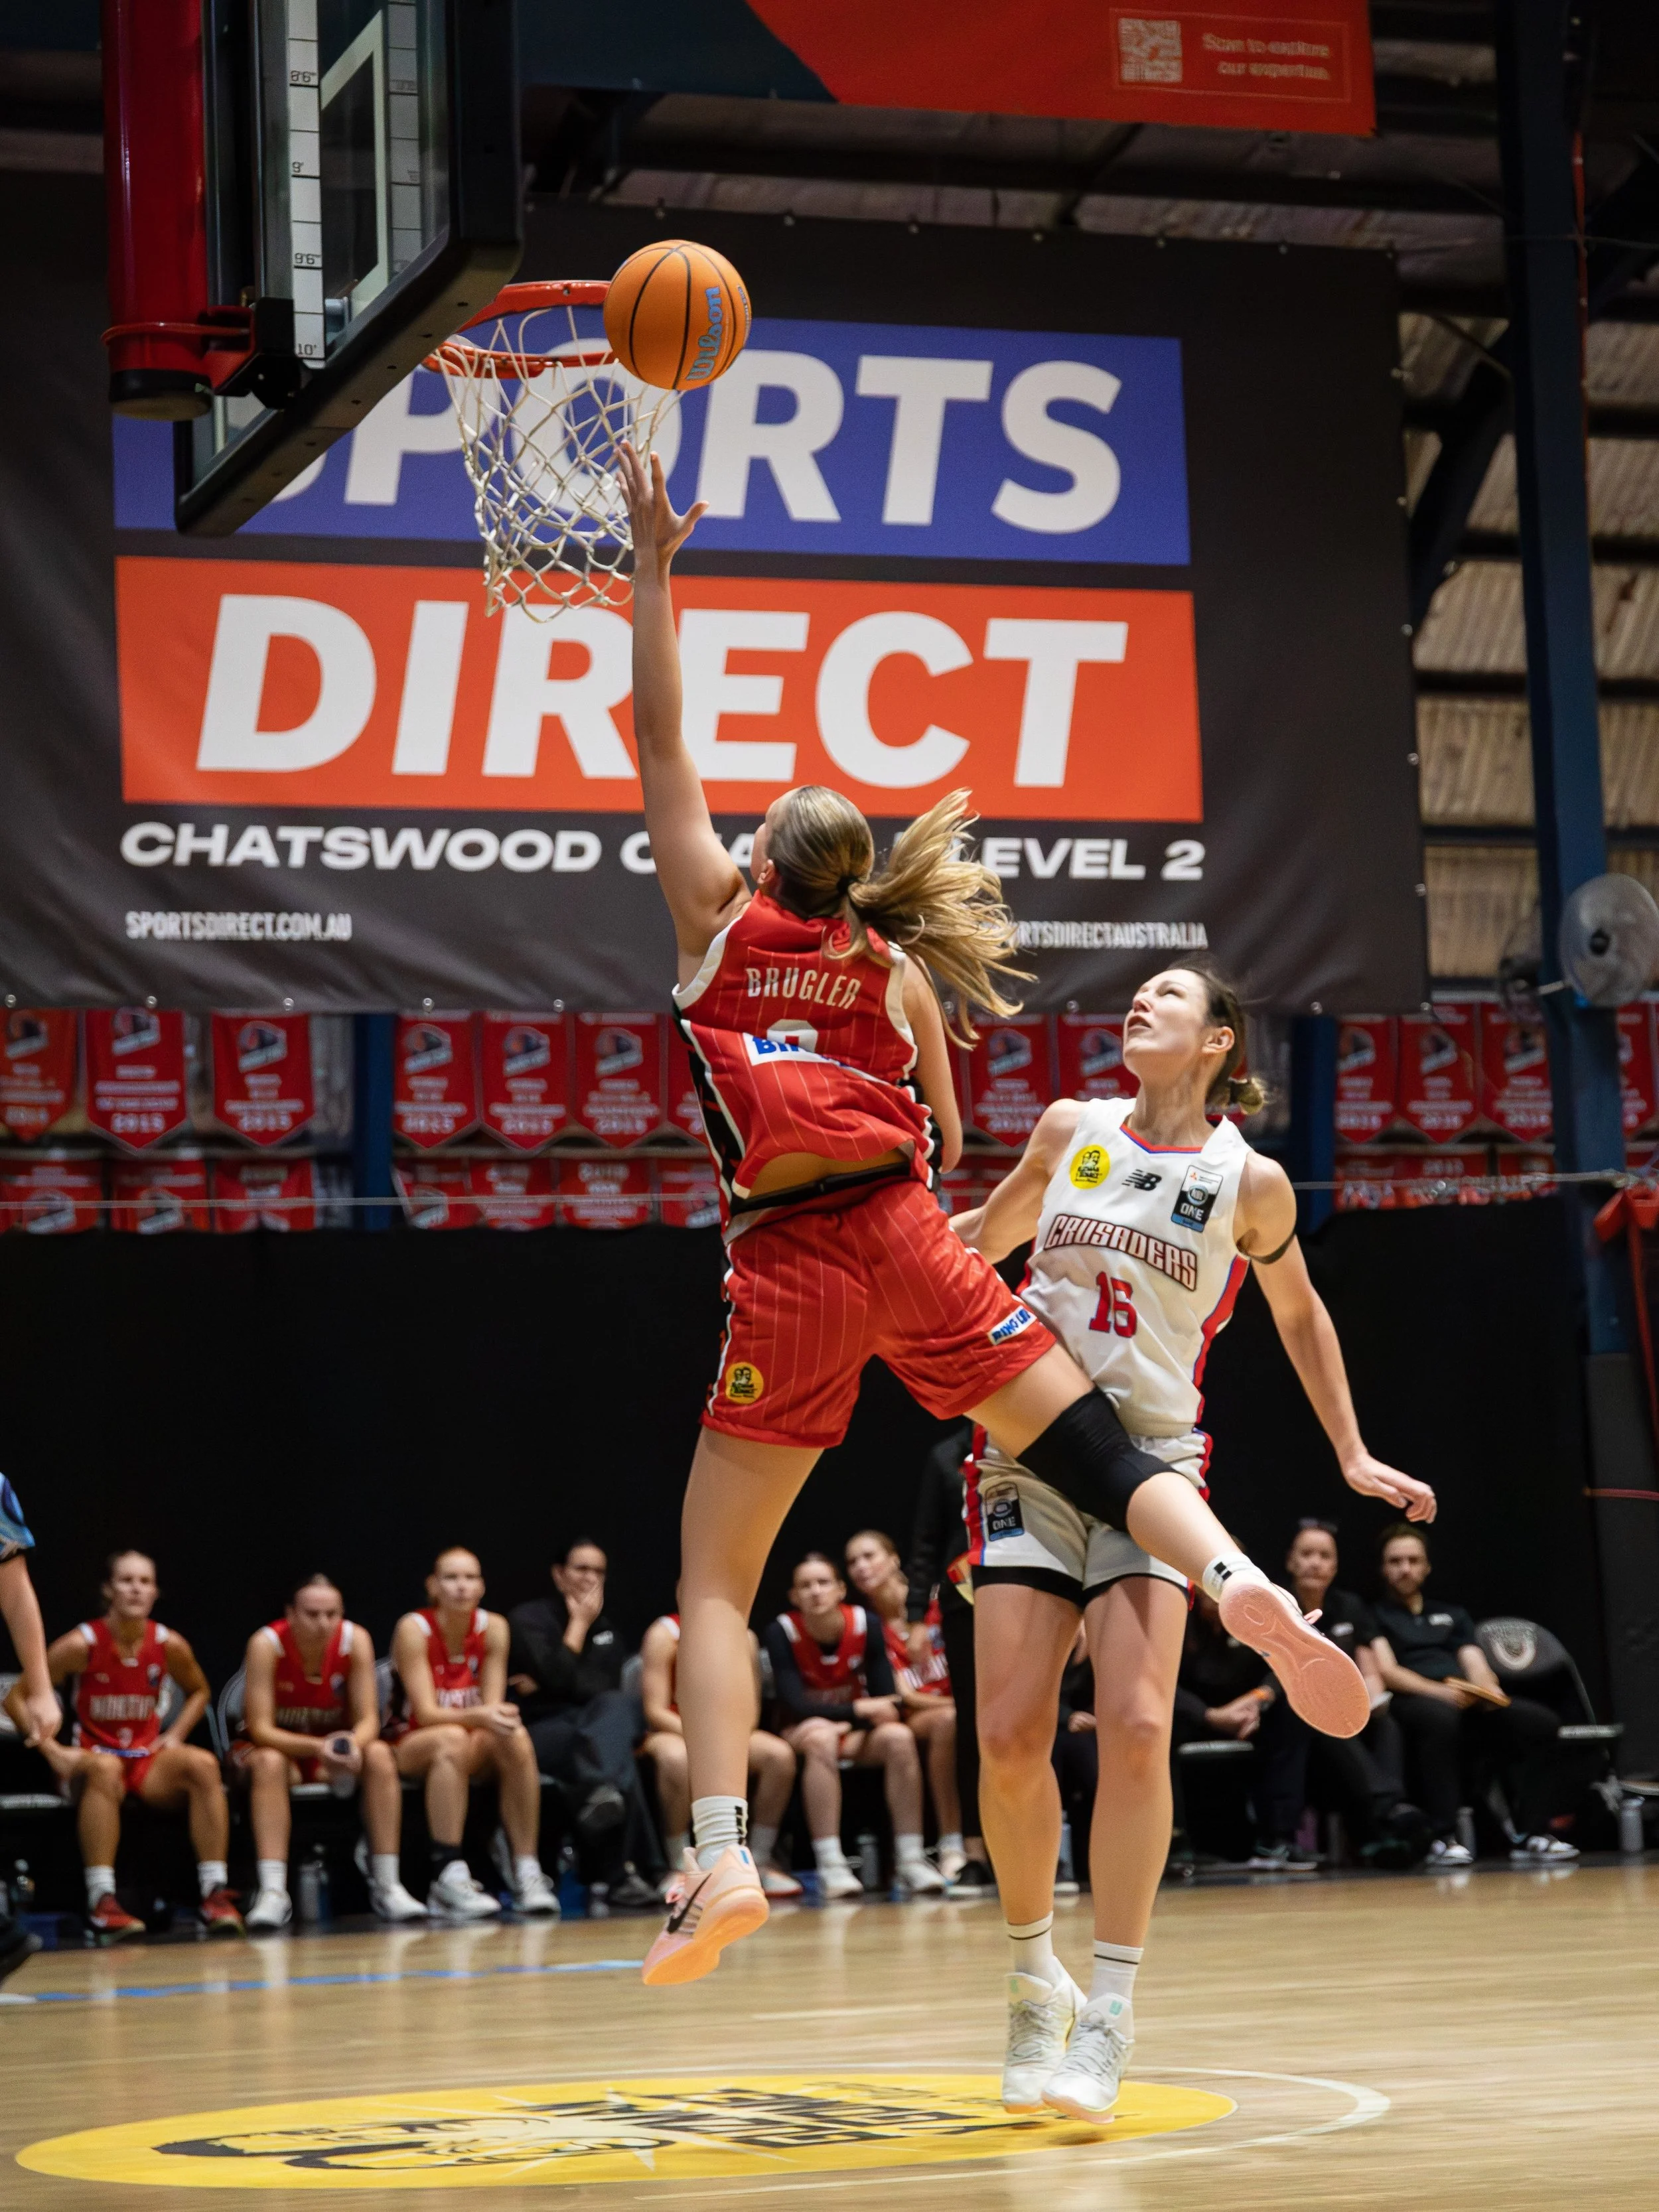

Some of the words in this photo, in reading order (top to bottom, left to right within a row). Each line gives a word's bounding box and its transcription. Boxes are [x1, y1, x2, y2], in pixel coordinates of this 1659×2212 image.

[298, 344, 317, 356] 10'
[685, 286, 723, 381] Wilson
[269, 335, 1121, 535] PORTS
[196, 592, 1129, 790] DIRECT
[120, 822, 603, 873] CHATSWOOD
[1161, 839, 1206, 881] 2
[745, 966, 862, 1010] BRUGLER
[1180, 1203, 1204, 1221] ONE
[1045, 1214, 1197, 1292] CRUSADERS
[992, 1516, 1016, 1531] ONE
